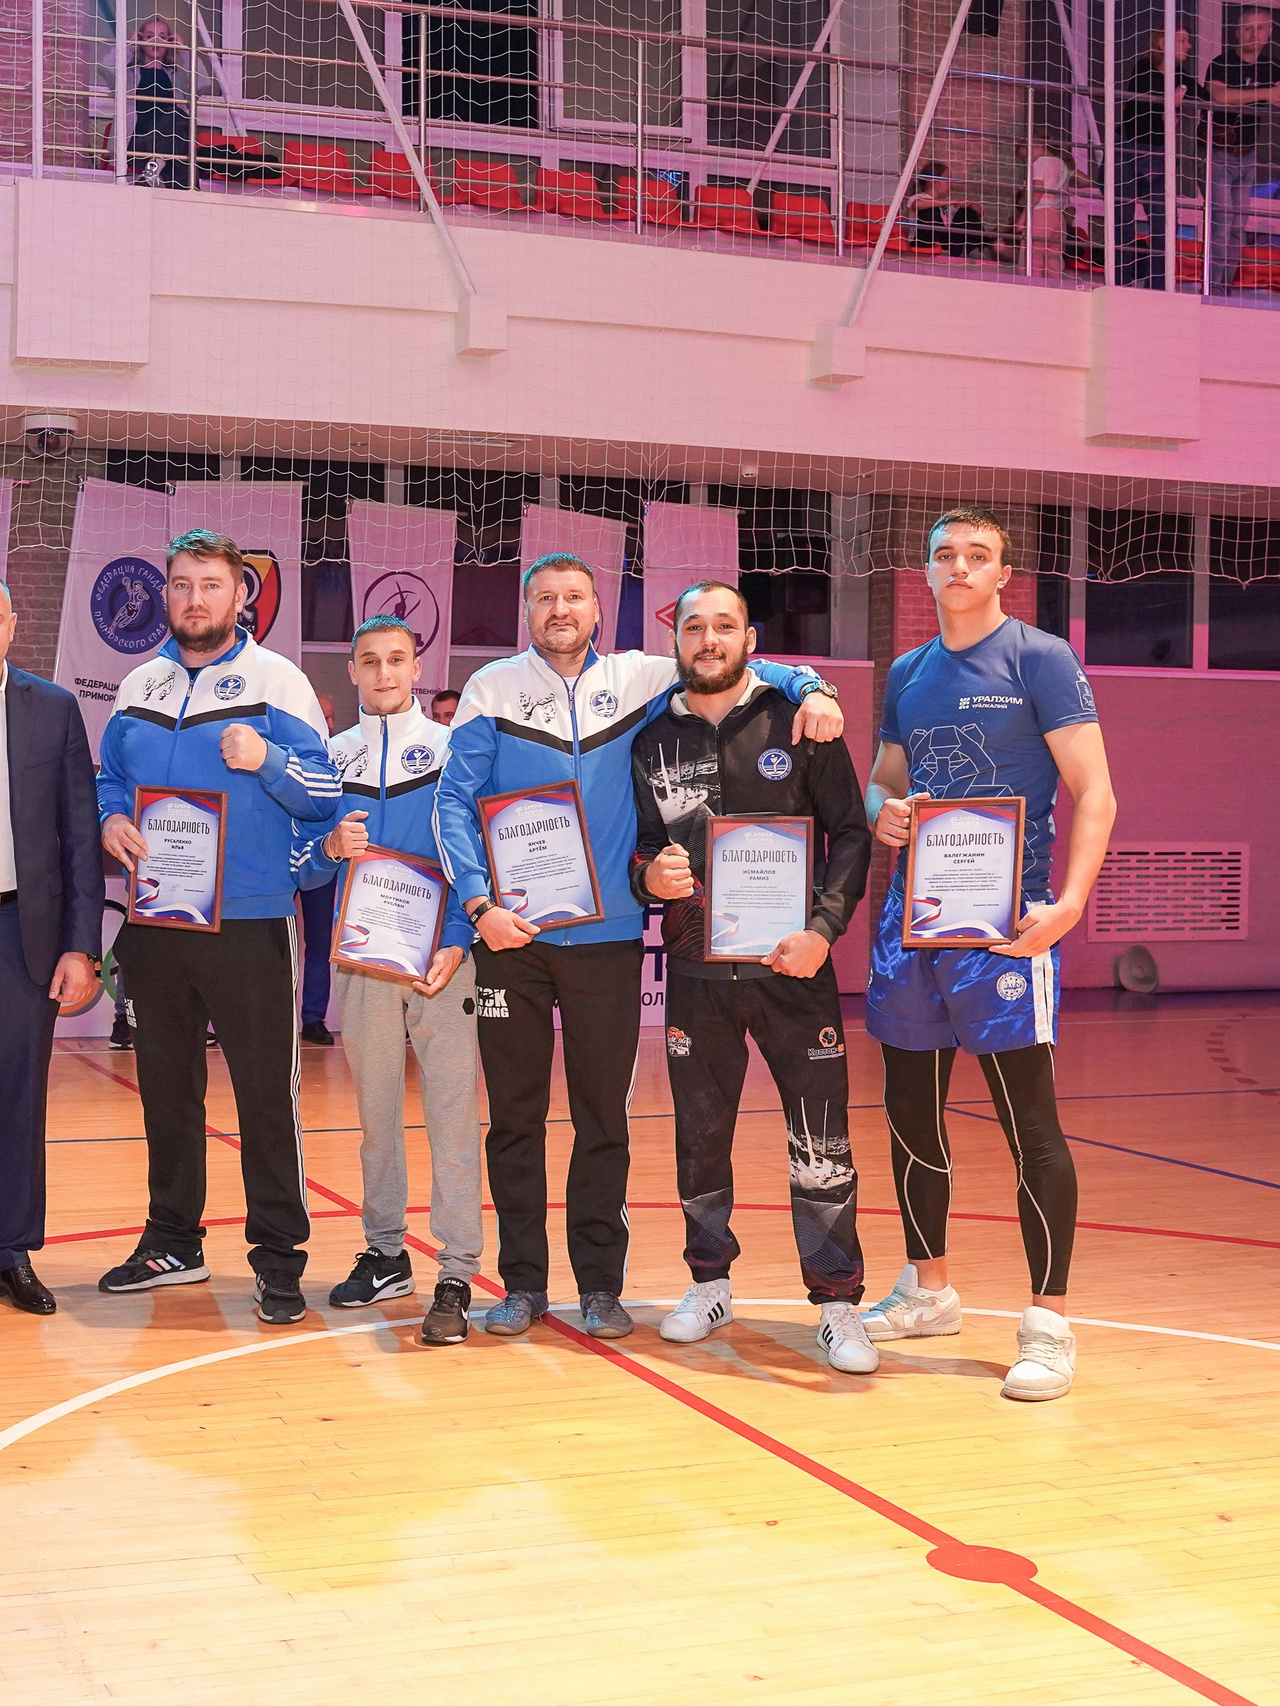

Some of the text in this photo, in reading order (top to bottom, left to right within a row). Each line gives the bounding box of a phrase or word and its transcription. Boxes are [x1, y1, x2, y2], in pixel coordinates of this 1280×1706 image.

[95, 565, 136, 601] ФЕДЕРАЦИЯ
[94, 610, 167, 648] ПРИМОРСКОГО КРАЯ
[74, 676, 120, 693] ФЕДЕРАЦИ
[971, 695, 1023, 706] УРАЛХИМ
[147, 818, 211, 835] БЛАГОДАРНОСТЬ
[497, 815, 571, 841] БЛАГОДАРНОСТЬ
[926, 832, 1005, 847] БЛАГОДАРНОСТЬ
[528, 845, 548, 853] АРТЁМ
[721, 849, 798, 863] БЛАГОДАРНОСТЬ
[362, 873, 432, 900] БЛАГОДАРНОСТЬ
[380, 893, 410, 904] МОРТИКОВ
[383, 900, 405, 909] РУСЛАН
